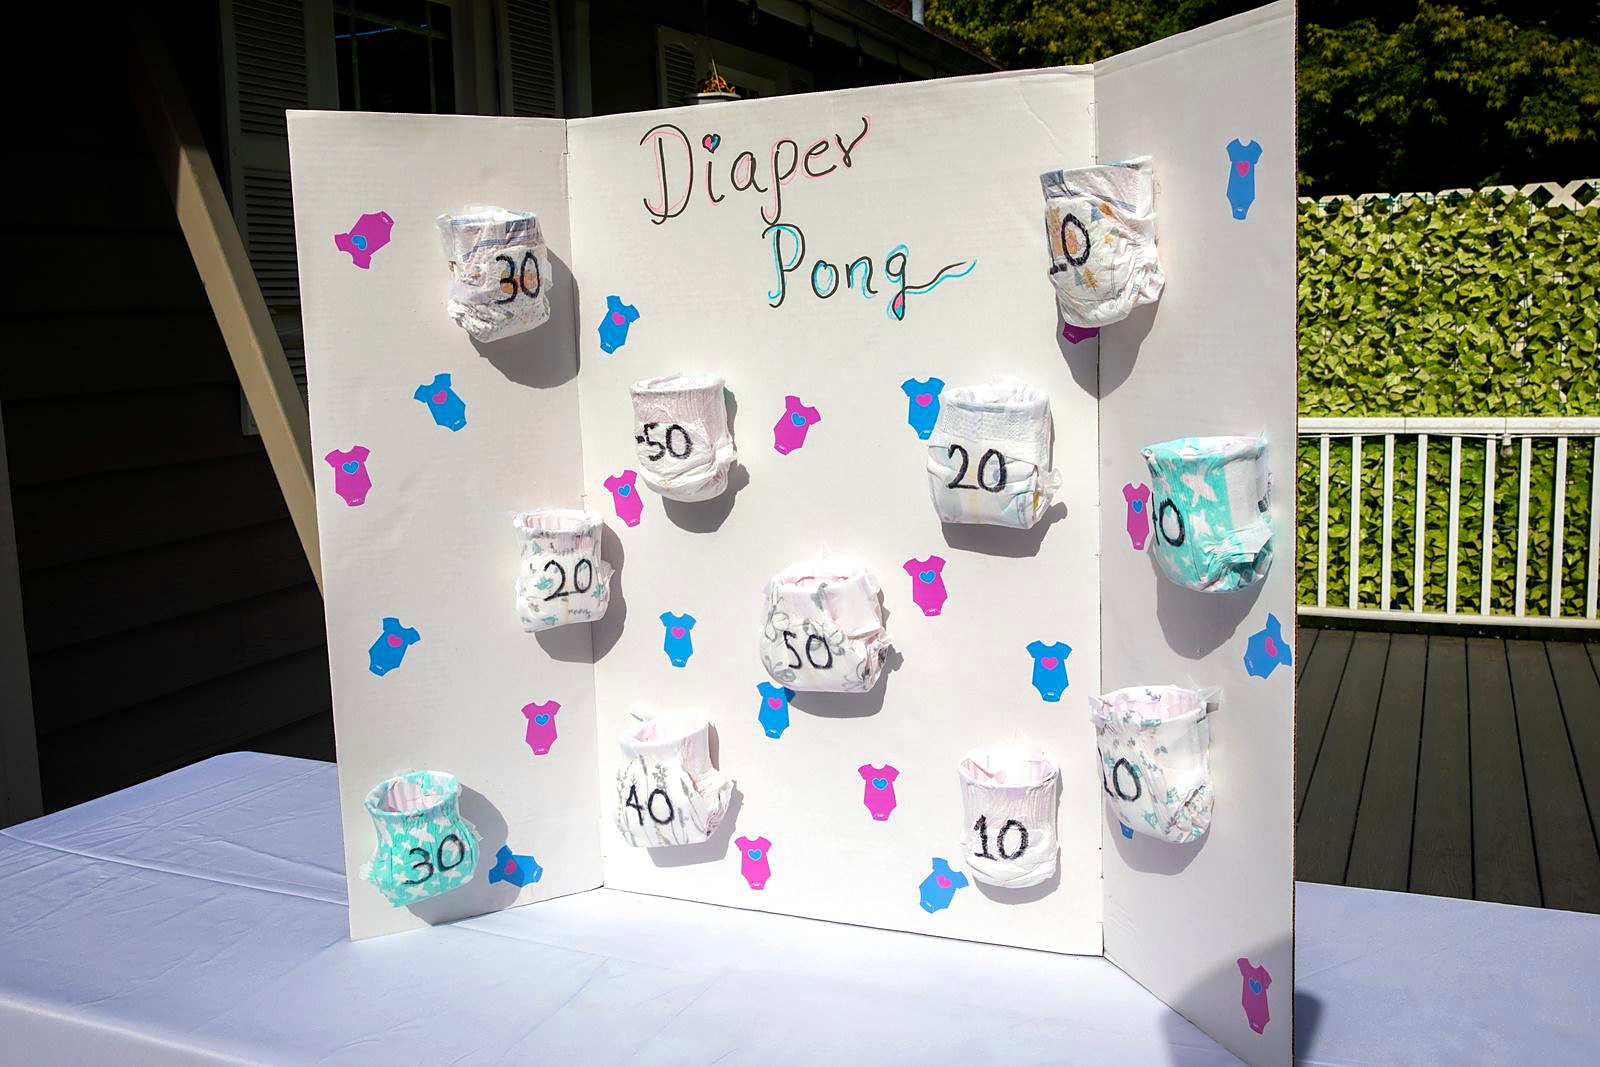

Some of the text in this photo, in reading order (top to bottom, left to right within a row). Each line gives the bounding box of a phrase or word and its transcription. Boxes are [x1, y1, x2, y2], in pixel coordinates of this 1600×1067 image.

[639, 115, 870, 225] Diaper
[494, 252, 541, 304] 30
[761, 223, 977, 321] Pong
[947, 444, 1007, 493] 20
[543, 559, 592, 601] 20
[783, 630, 833, 669] 50
[626, 784, 674, 825] 40
[401, 833, 465, 885] 30
[973, 814, 1029, 861] 10
